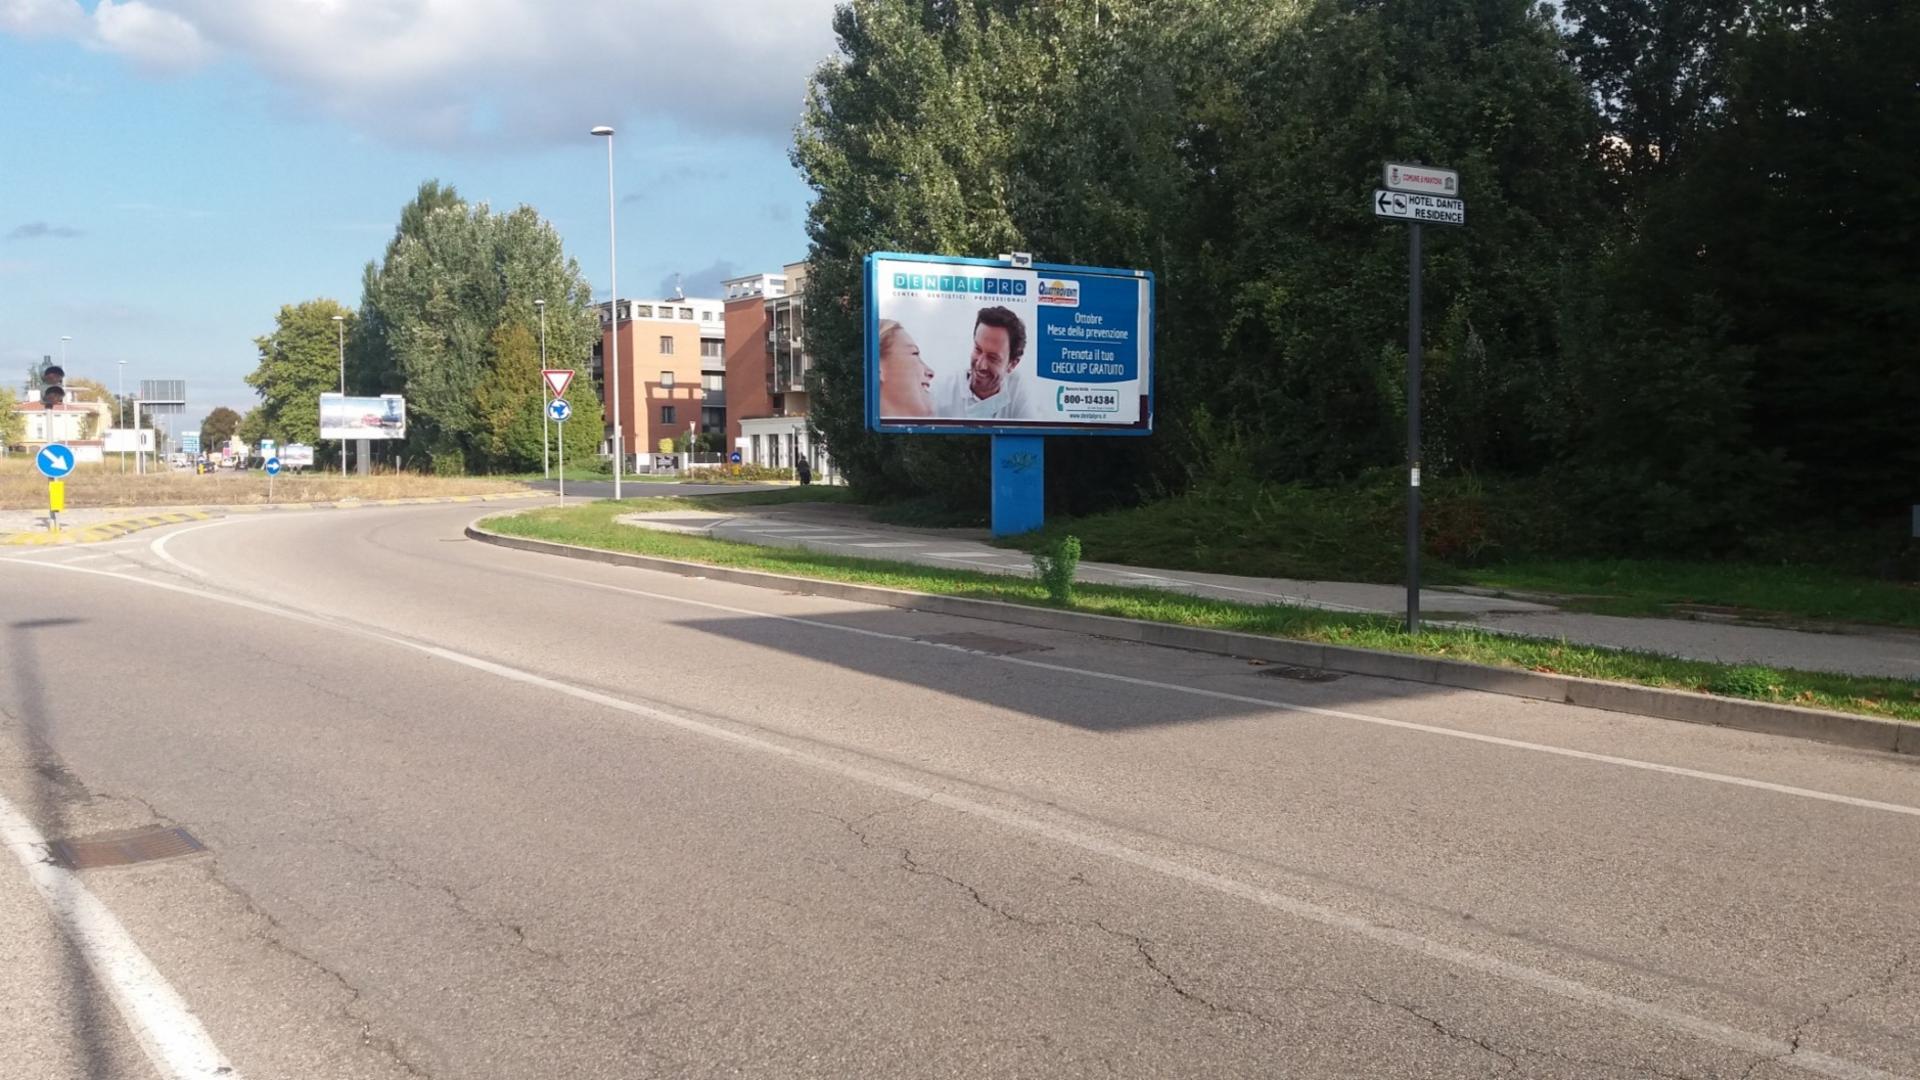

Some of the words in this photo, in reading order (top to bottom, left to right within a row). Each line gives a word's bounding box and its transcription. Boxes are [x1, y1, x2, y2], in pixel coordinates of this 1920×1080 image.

[1409, 195, 1434, 207] HOTEL
[1436, 198, 1462, 210] DANTE
[1415, 209, 1462, 222] RESIDENCE
[894, 273, 1026, 295] DENTALPRO
[1074, 312, 1103, 325] Ottobre
[1047, 324, 1066, 336] Mese
[1067, 325, 1085, 337] della
[1086, 327, 1128, 340] prevenzione
[1061, 347, 1093, 360] Prenota
[1094, 348, 1100, 361] il
[1101, 349, 1114, 361] tuo
[1051, 361, 1076, 374] CHECK
[1076, 362, 1087, 374] UP
[1089, 363, 1124, 376] GRATUITO
